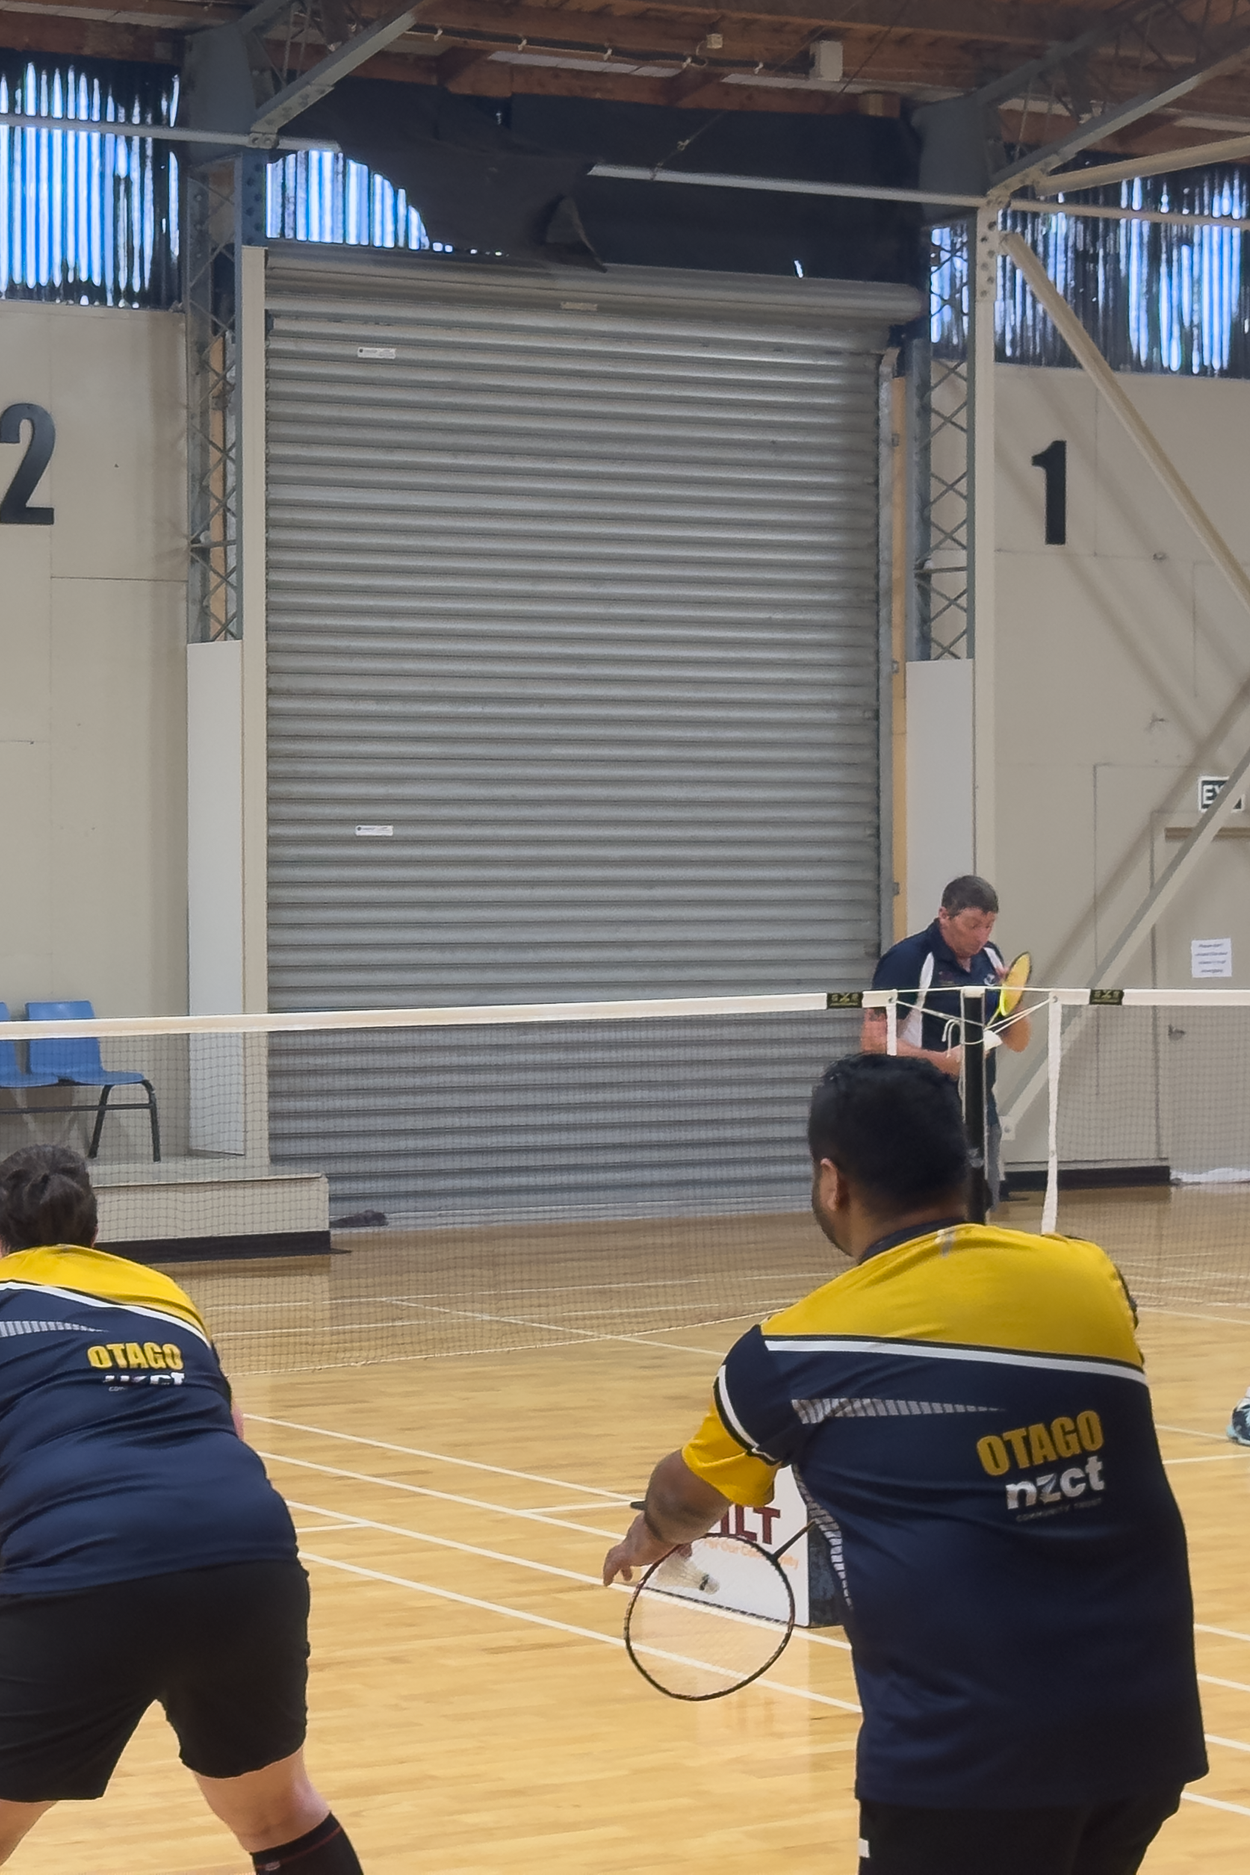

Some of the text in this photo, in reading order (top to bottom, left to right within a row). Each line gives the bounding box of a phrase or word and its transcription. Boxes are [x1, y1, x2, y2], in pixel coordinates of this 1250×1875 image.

[1031, 440, 1066, 545] 1
[87, 1342, 184, 1370] OTAGO
[976, 1410, 1104, 1476] OTAGO
[1005, 1455, 1105, 1510] nzct
